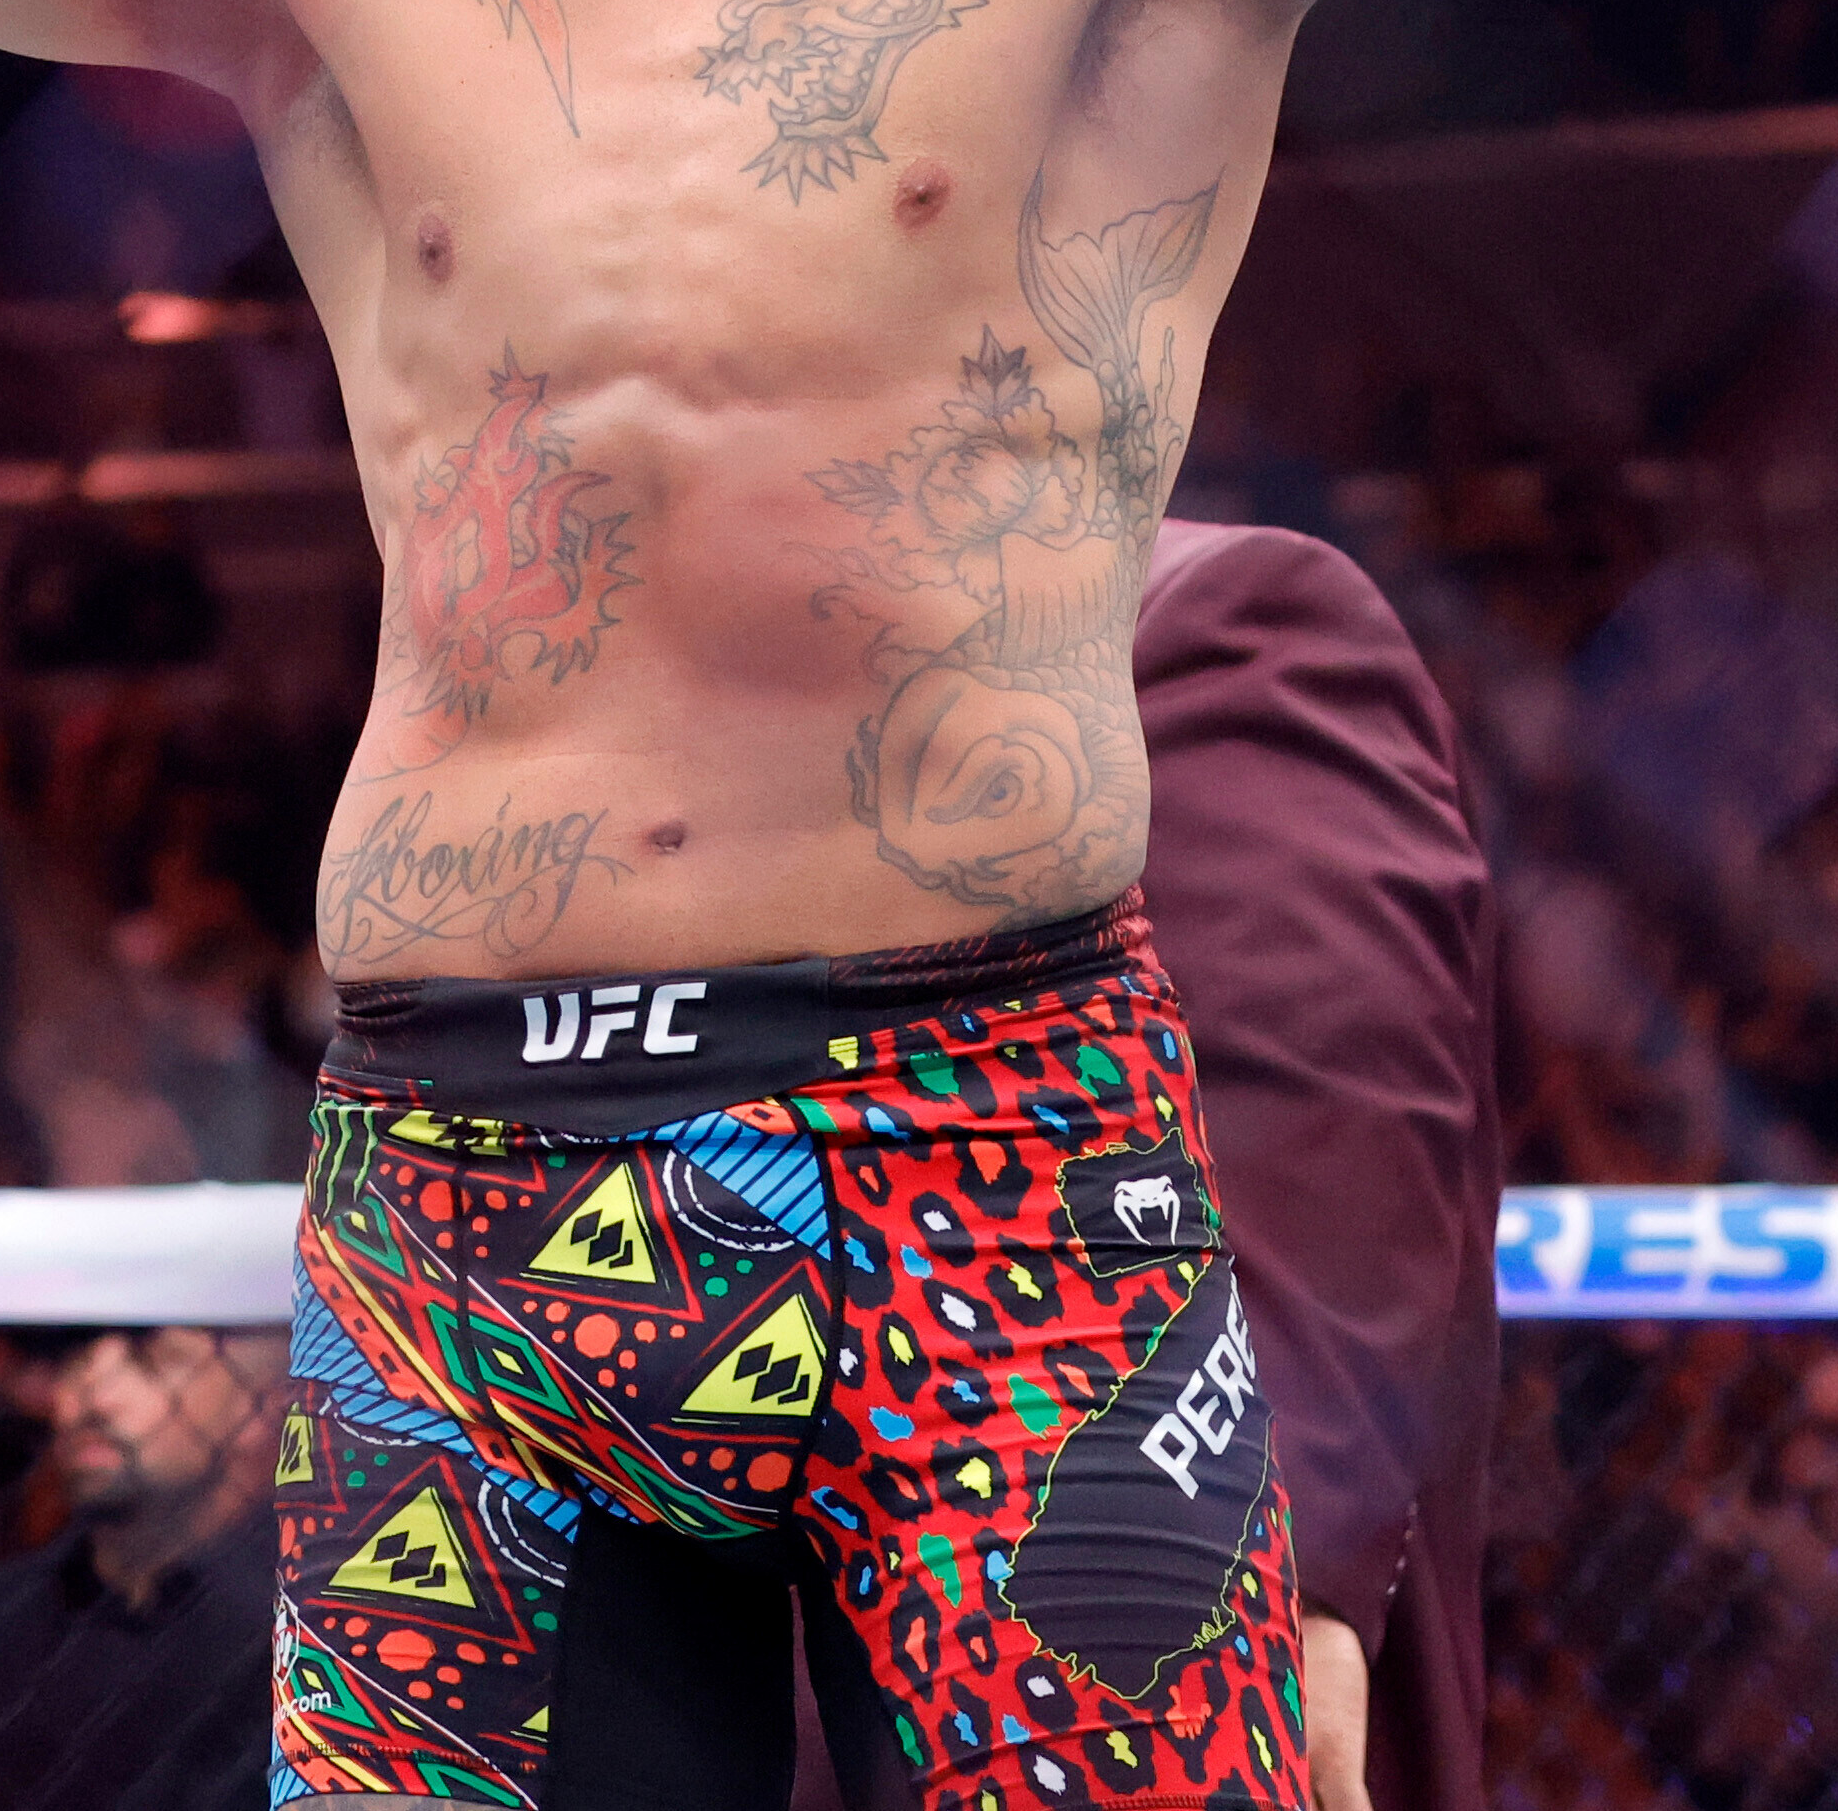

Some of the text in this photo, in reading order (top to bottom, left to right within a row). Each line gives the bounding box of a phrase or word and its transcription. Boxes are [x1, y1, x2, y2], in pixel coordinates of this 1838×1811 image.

[522, 982, 707, 1063] UFC
[1496, 1191, 1830, 1292] RES
[1139, 1255, 1256, 1500] PERE
